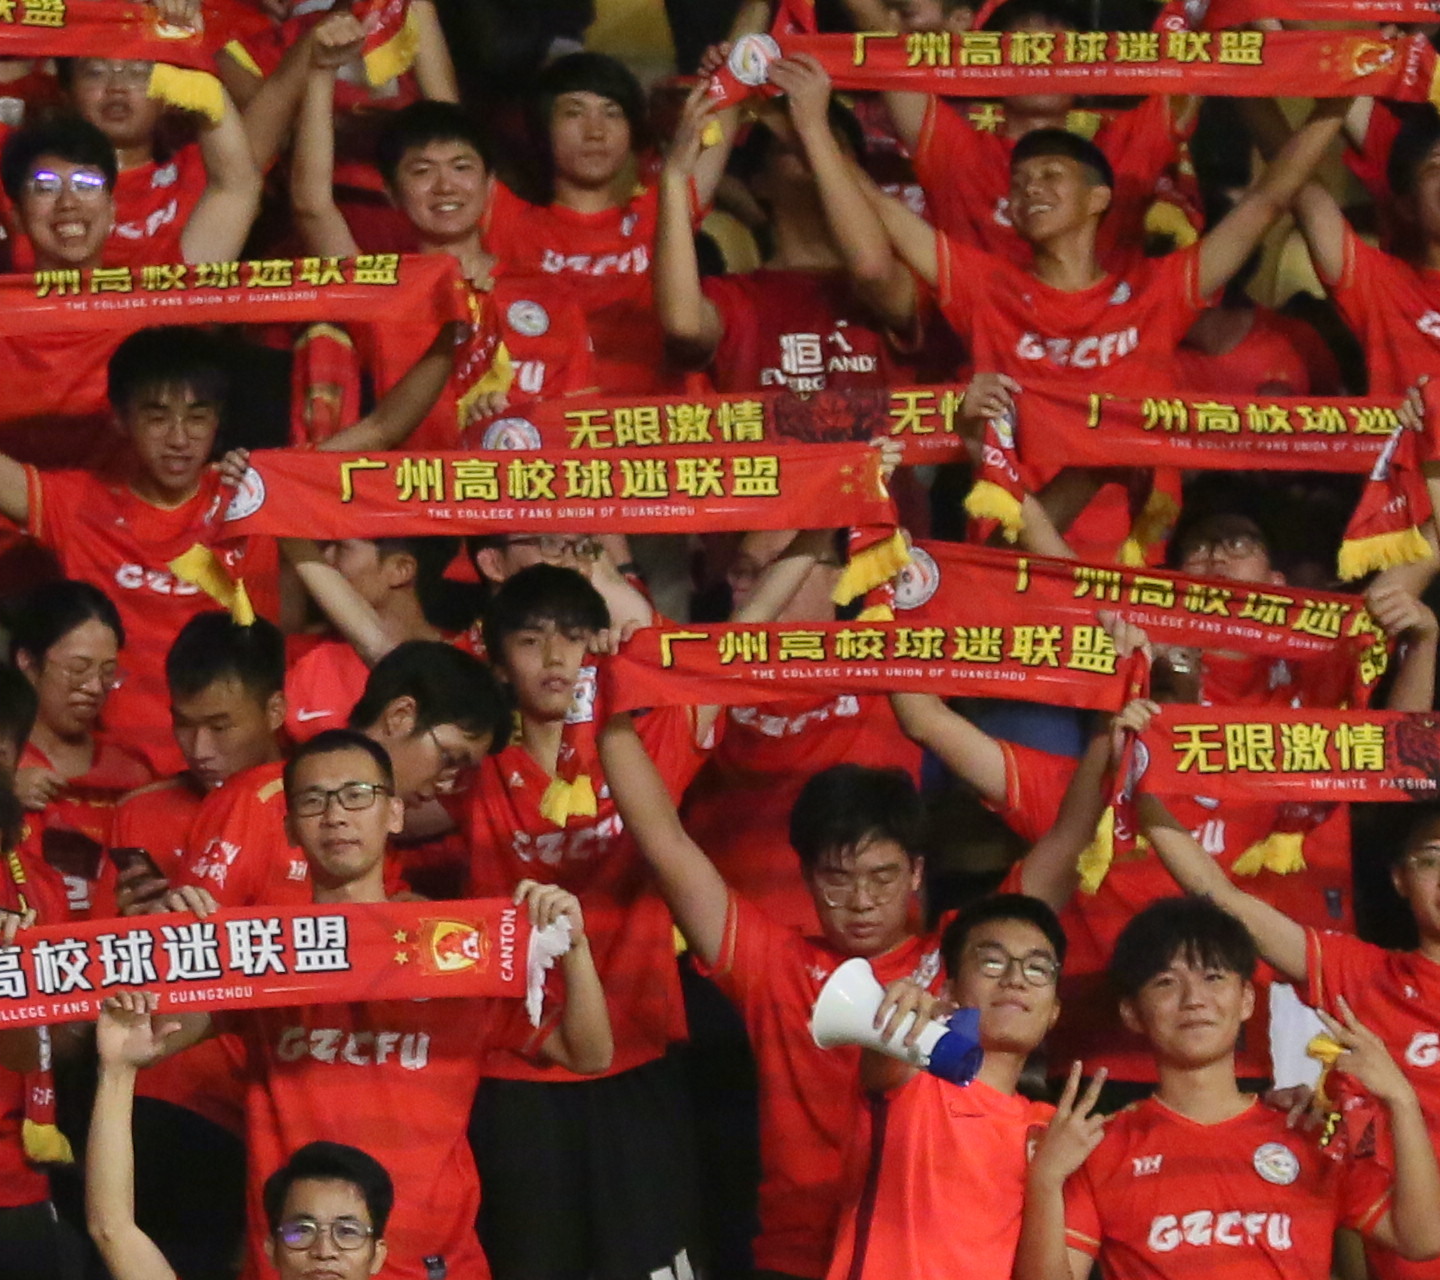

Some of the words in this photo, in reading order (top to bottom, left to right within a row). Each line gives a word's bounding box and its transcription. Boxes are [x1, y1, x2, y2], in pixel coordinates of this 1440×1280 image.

[853, 31, 1264, 67] 广州高校球迷联盟
[1015, 327, 1139, 369] GZCFU
[565, 400, 765, 448] 无限激情
[340, 456, 780, 502] 广州高校球迷联盟
[428, 508, 449, 518] THE
[457, 508, 513, 518] COLLEGE
[519, 508, 552, 518] FANS
[557, 507, 594, 517] UNION
[600, 506, 615, 517] OF
[622, 506, 695, 517] GUANGZHOU
[659, 626, 1117, 674] 广州高校球迷联盟
[752, 670, 775, 680] THE
[782, 668, 840, 678] COLLEGE
[846, 668, 880, 678] FANS
[885, 668, 923, 678] UNION
[929, 668, 945, 678] OF
[951, 670, 1026, 681] GUANGZHOU
[1173, 723, 1385, 773] 无限激情
[1311, 780, 1366, 790] INFINITE
[1380, 779, 1437, 790] PASSION
[501, 908, 515, 982] CANTON
[52, 1003, 88, 1018] FANS
[169, 985, 253, 1002] GUANGZHOU
[277, 1027, 430, 1071] GZCFU
[1148, 1209, 1292, 1254] GZCFU
